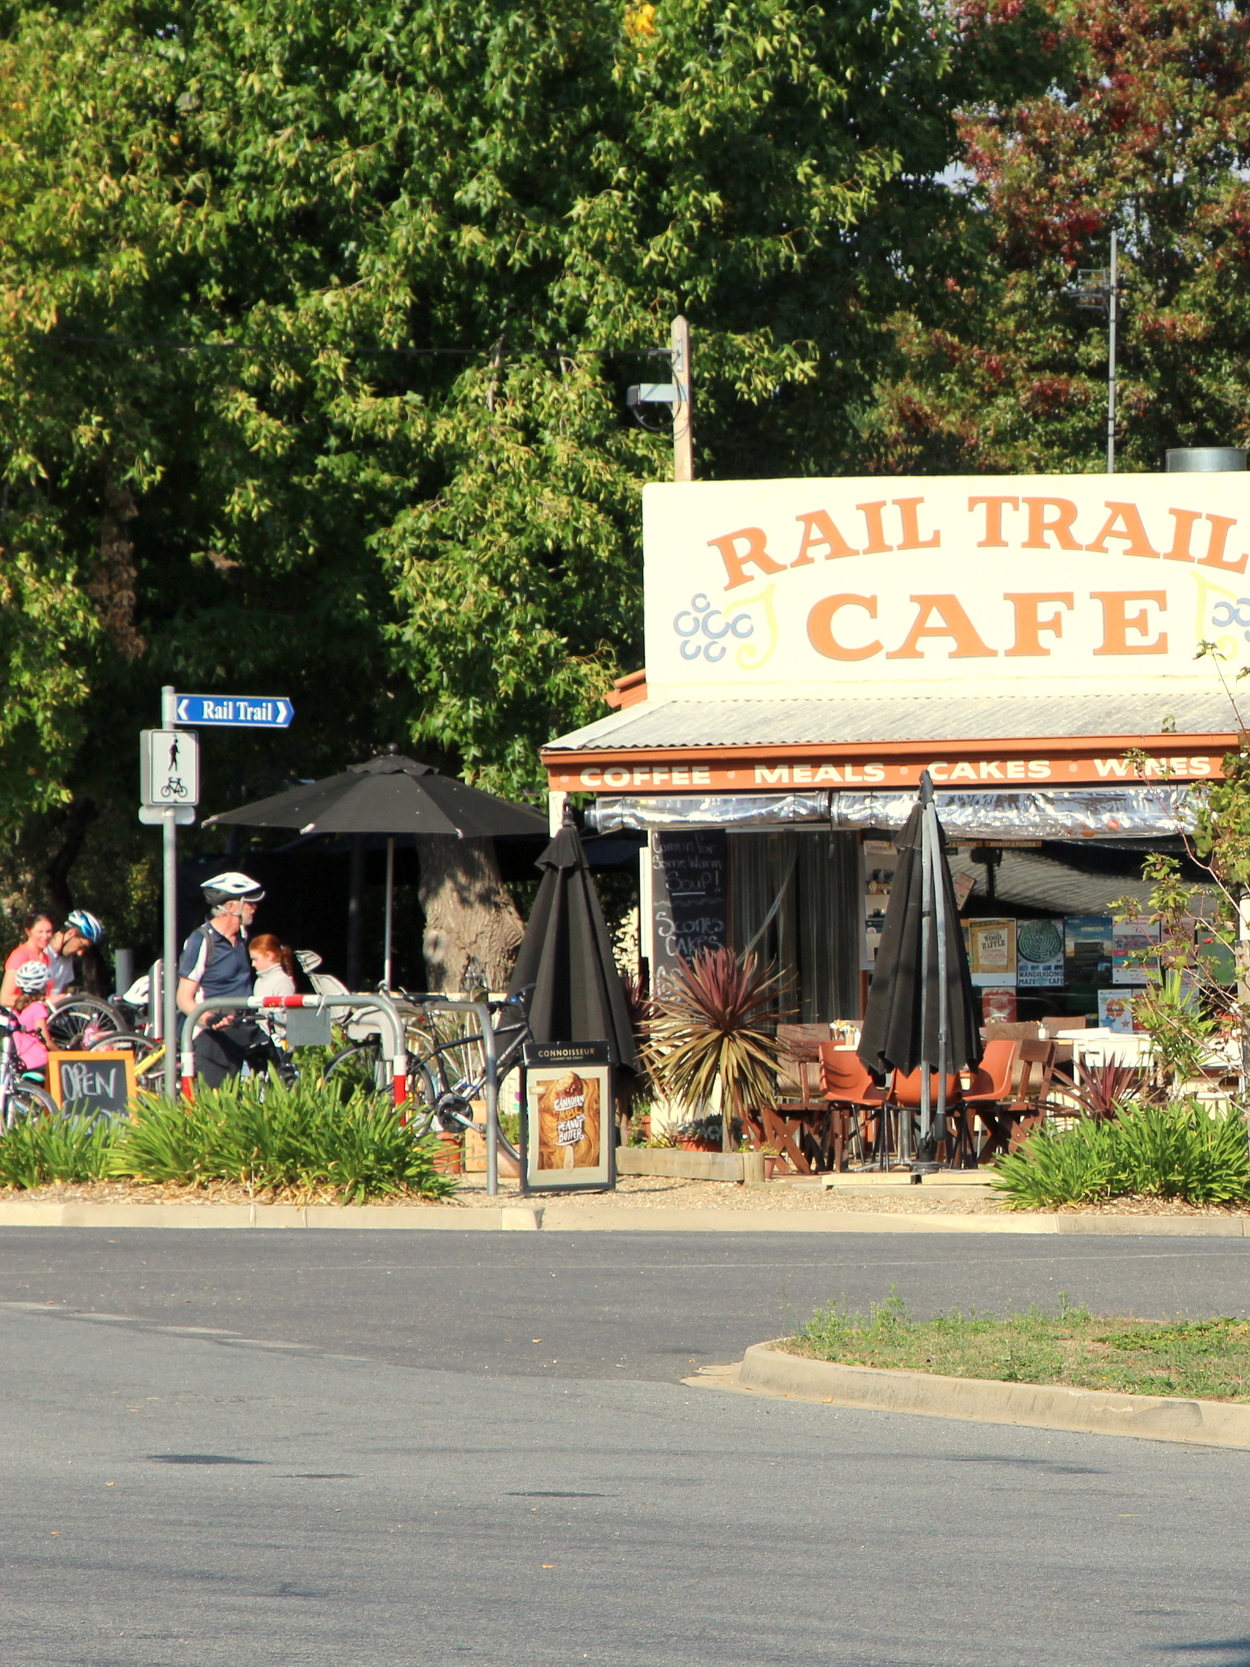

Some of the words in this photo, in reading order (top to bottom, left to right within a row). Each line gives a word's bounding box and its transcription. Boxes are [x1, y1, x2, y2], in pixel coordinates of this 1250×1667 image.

[707, 496, 941, 592] RAIL
[968, 495, 1249, 574] TRAIL
[807, 590, 1169, 663] CAFE
[202, 700, 233, 720] Rail
[236, 701, 272, 721] Trail
[580, 765, 711, 787] COFFEE
[754, 762, 886, 783] MEALS
[926, 759, 1051, 781] CAKES
[1019, 977, 1036, 985] MAZE
[538, 1048, 595, 1057] CONNOISSEUR
[61, 1062, 116, 1101] OPEN
[557, 1119, 583, 1131] PEANUT
[558, 1128, 585, 1143] BUTTER
